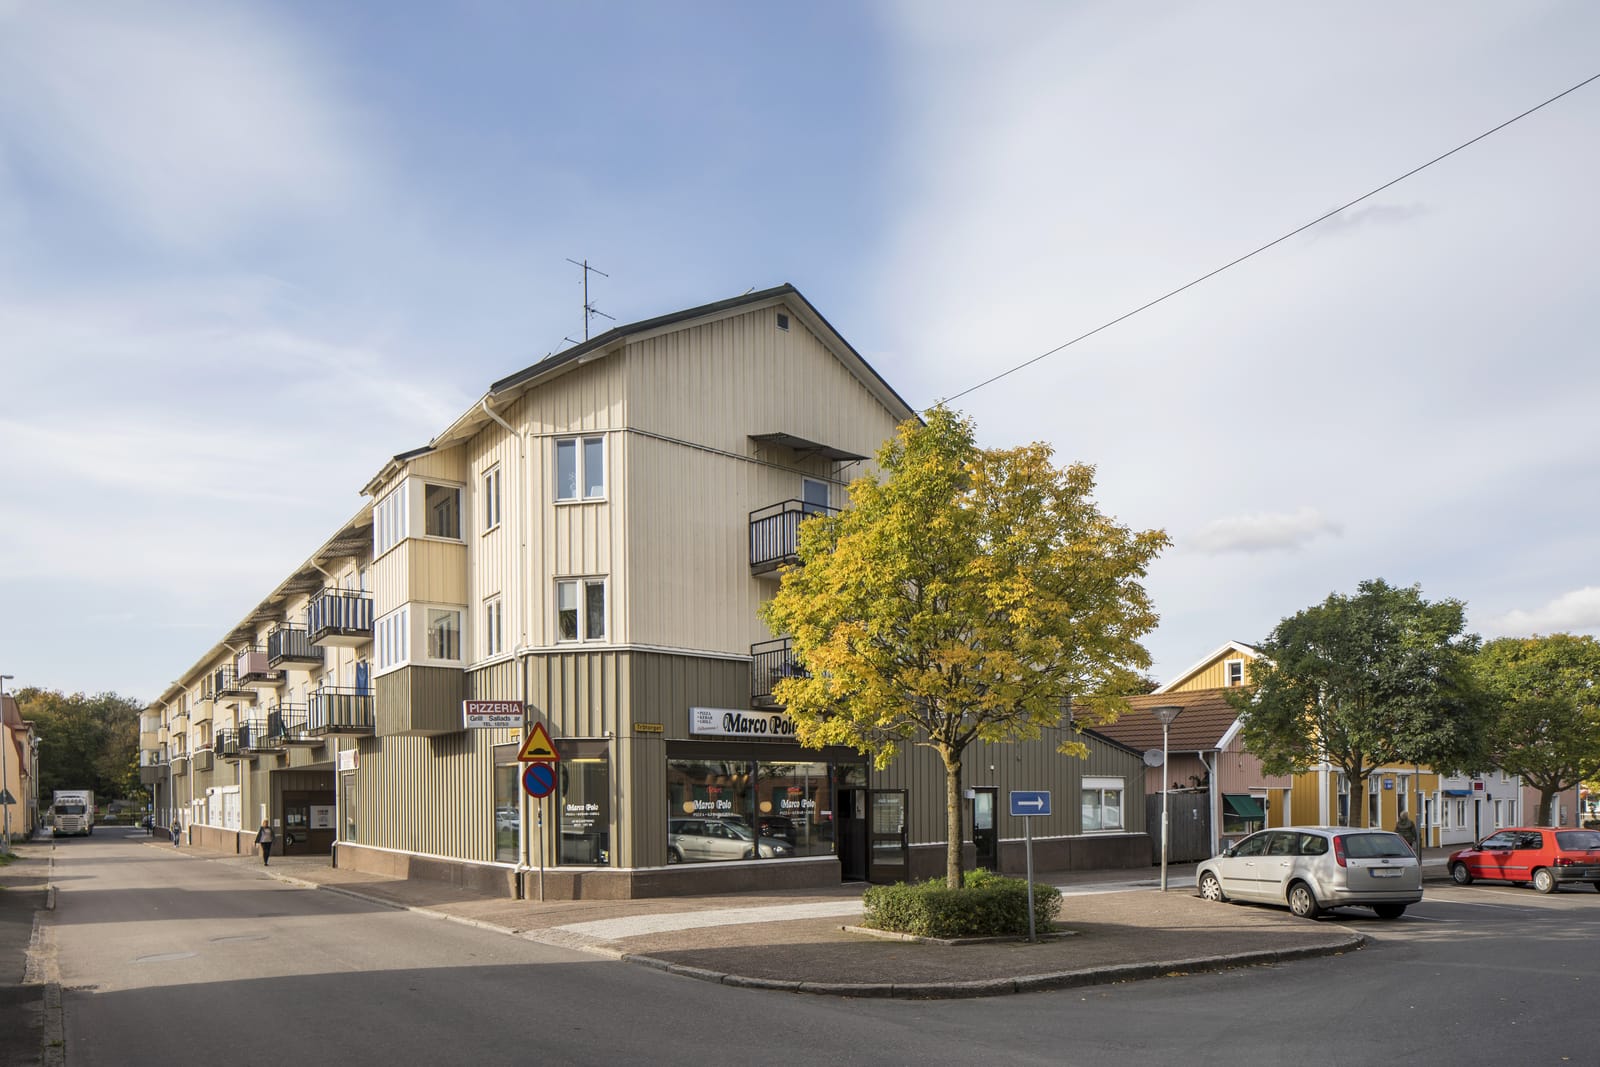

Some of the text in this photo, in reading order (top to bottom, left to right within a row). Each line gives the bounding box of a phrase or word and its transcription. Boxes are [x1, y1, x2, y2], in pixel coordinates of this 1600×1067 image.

[469, 703, 520, 713] PIZZERIA
[722, 712, 767, 733] Marco
[693, 799, 731, 810] Marco Polo
[781, 799, 800, 809] Marco
